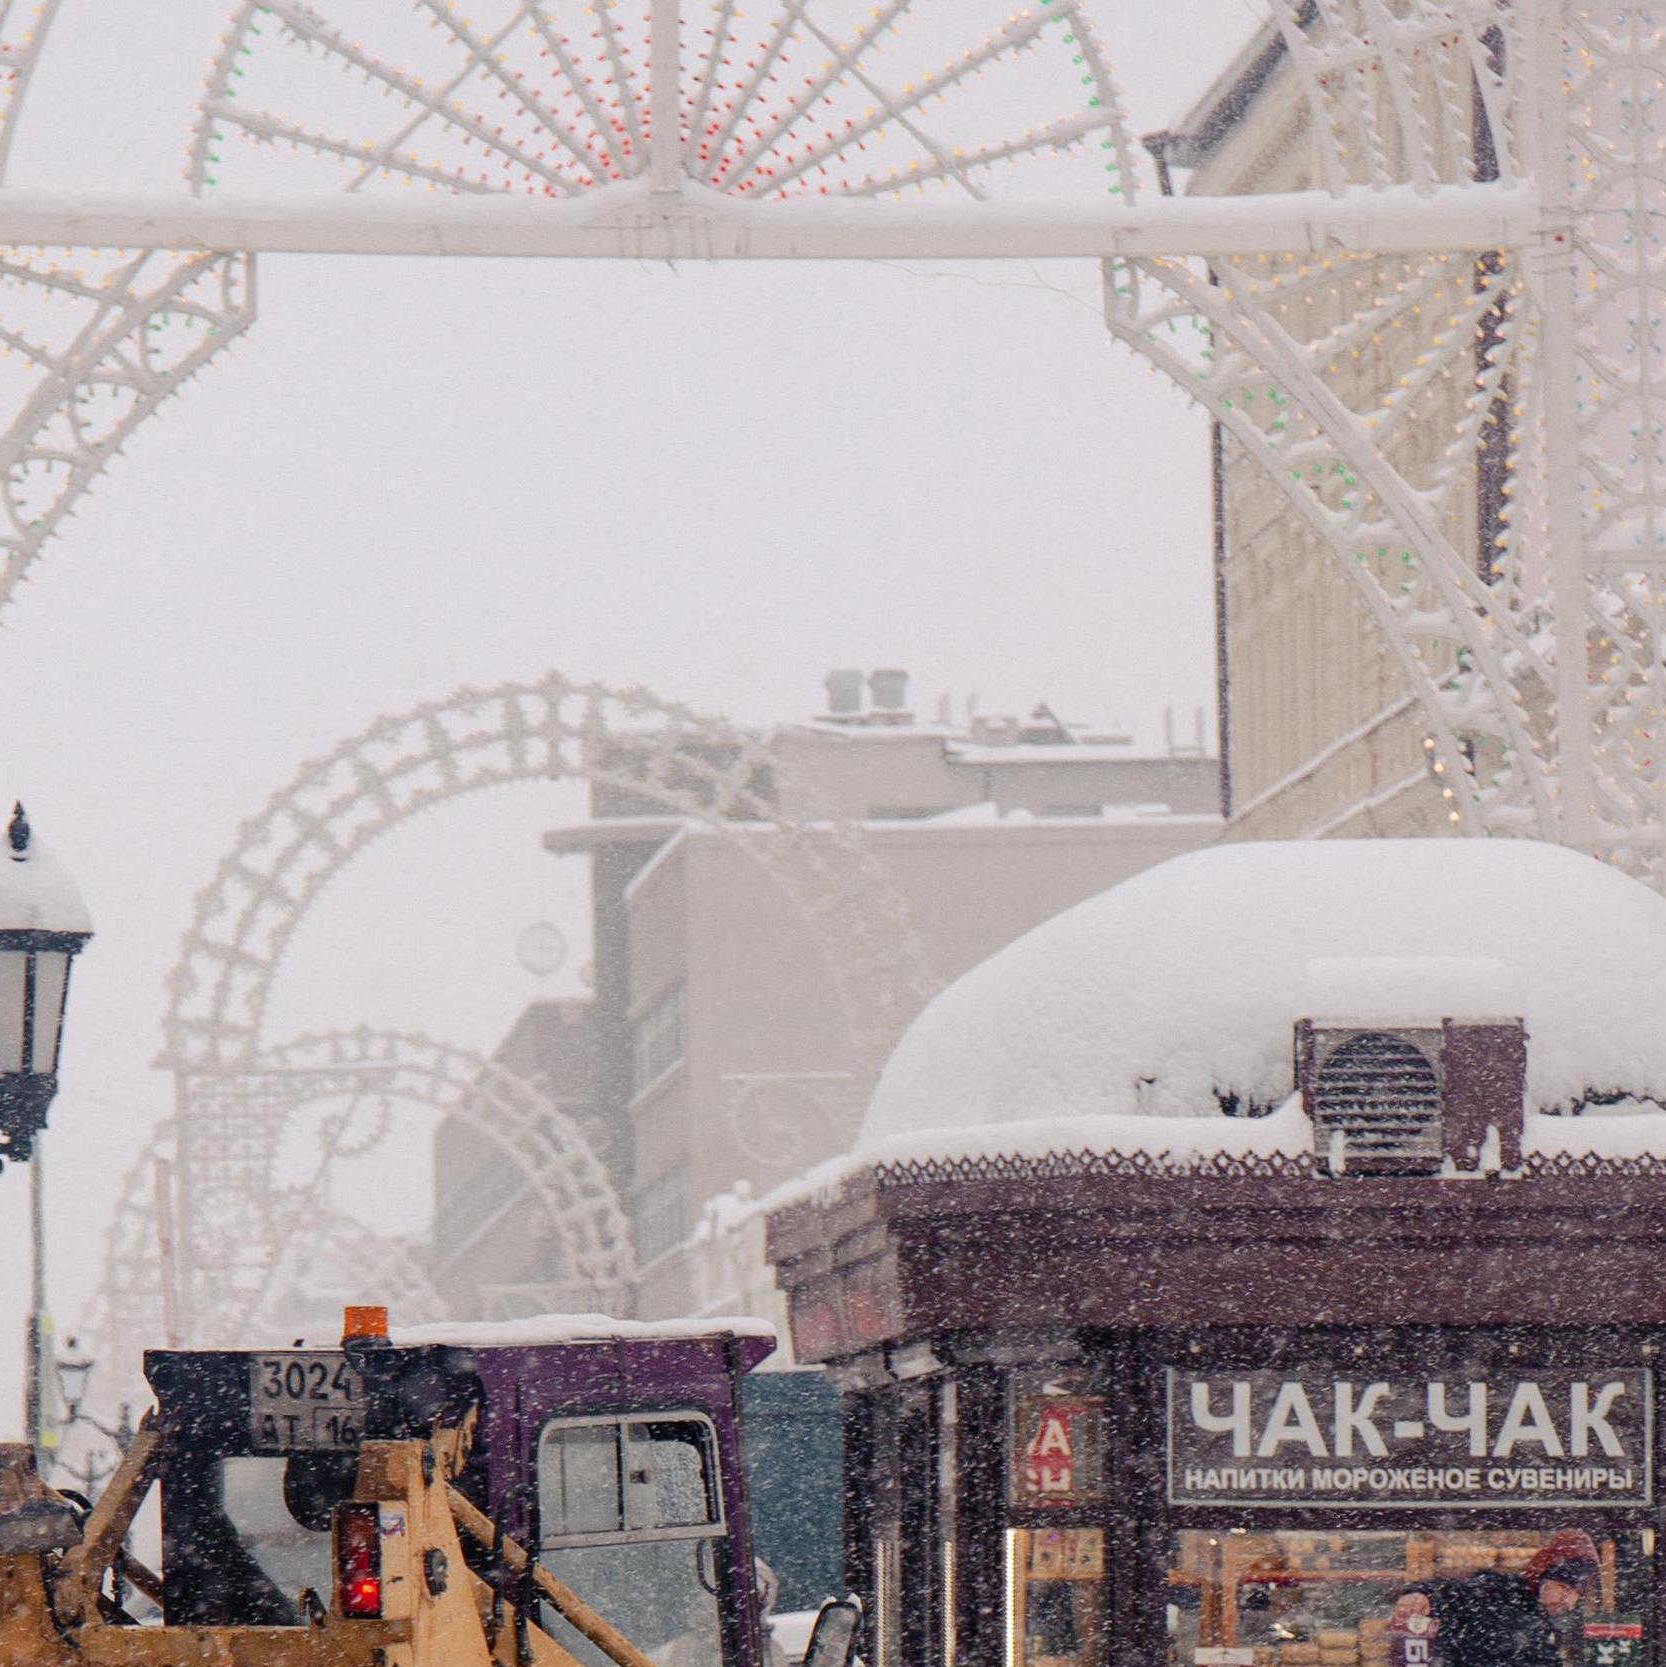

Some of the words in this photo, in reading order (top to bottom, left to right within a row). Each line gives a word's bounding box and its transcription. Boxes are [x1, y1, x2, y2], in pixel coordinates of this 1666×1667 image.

[263, 1361, 353, 1400] 3024
[325, 1415, 357, 1444] 16
[1190, 1381, 1626, 1458] ЧАК-ЧАК
[1185, 1467, 1305, 1490] НАПИТКИ
[1312, 1467, 1481, 1490] МОРОЖЕНОЕ
[1487, 1467, 1633, 1490] СУВЕНИРЫ
